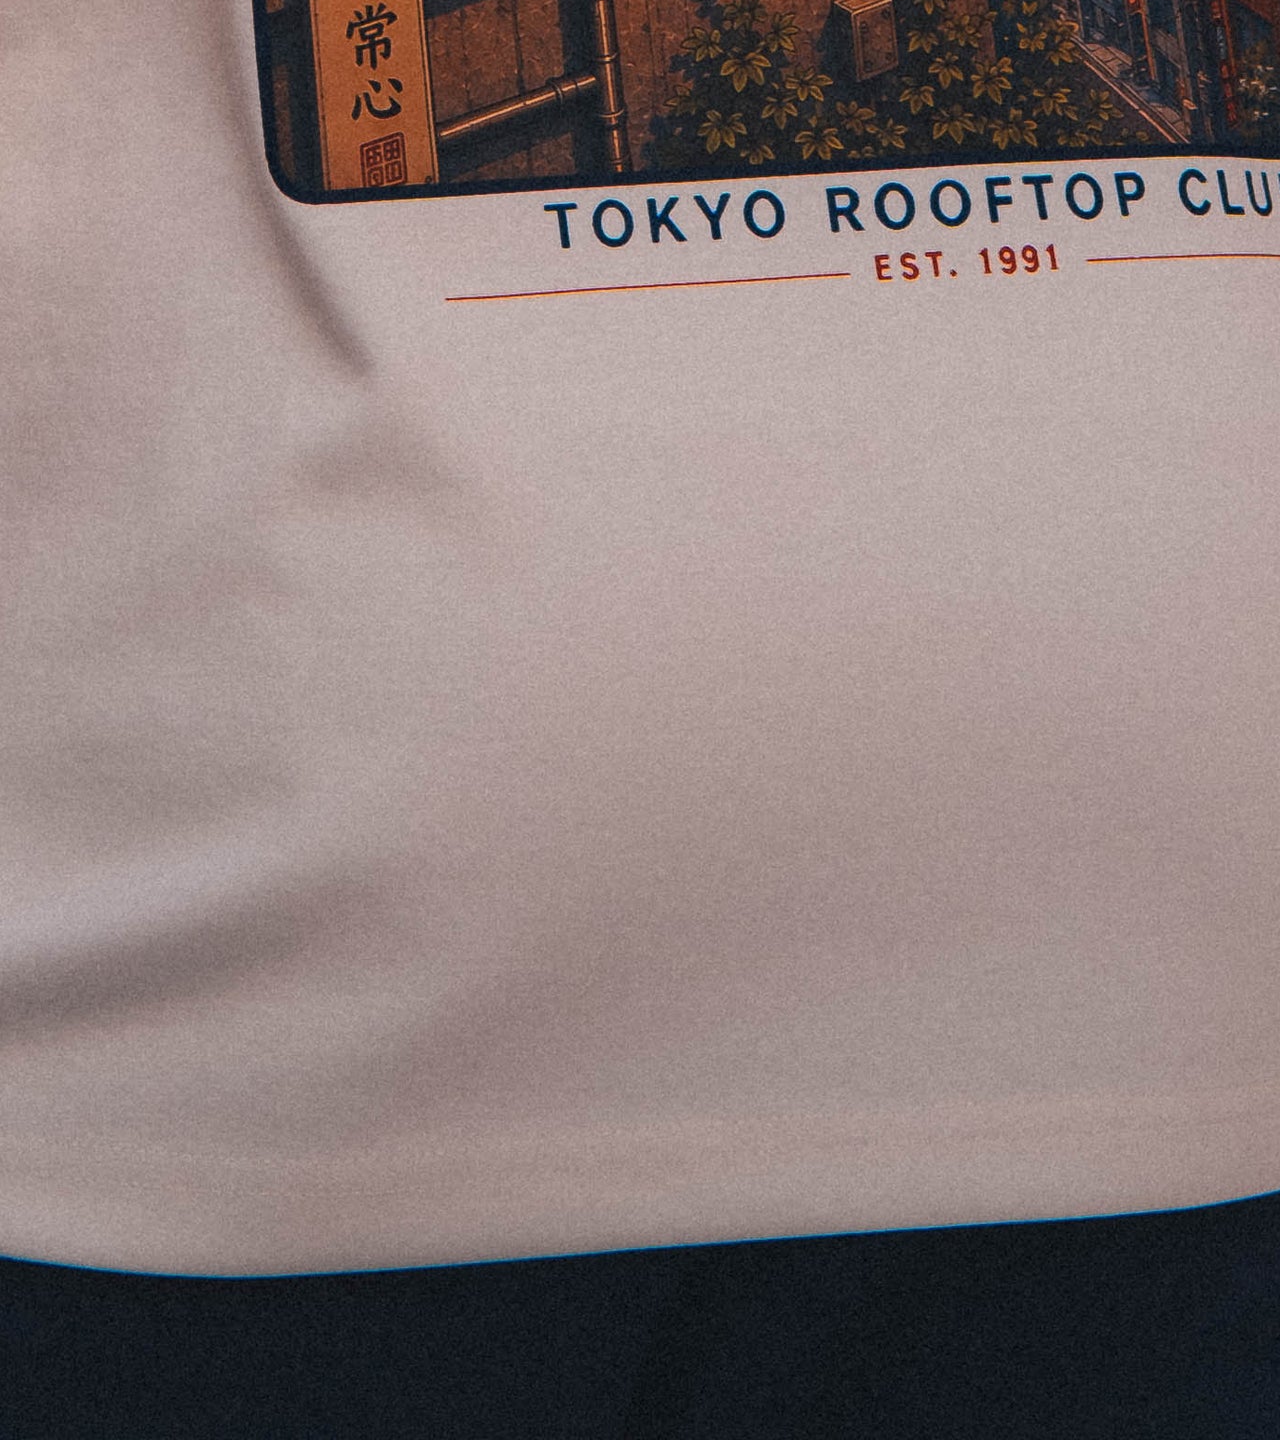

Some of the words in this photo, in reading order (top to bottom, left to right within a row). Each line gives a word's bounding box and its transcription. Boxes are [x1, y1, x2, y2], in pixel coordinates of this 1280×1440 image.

[543, 190, 787, 250] TOKYO
[824, 170, 1147, 234] ROOFTOP
[874, 250, 958, 281] EST.
[978, 243, 1059, 275] 1991
